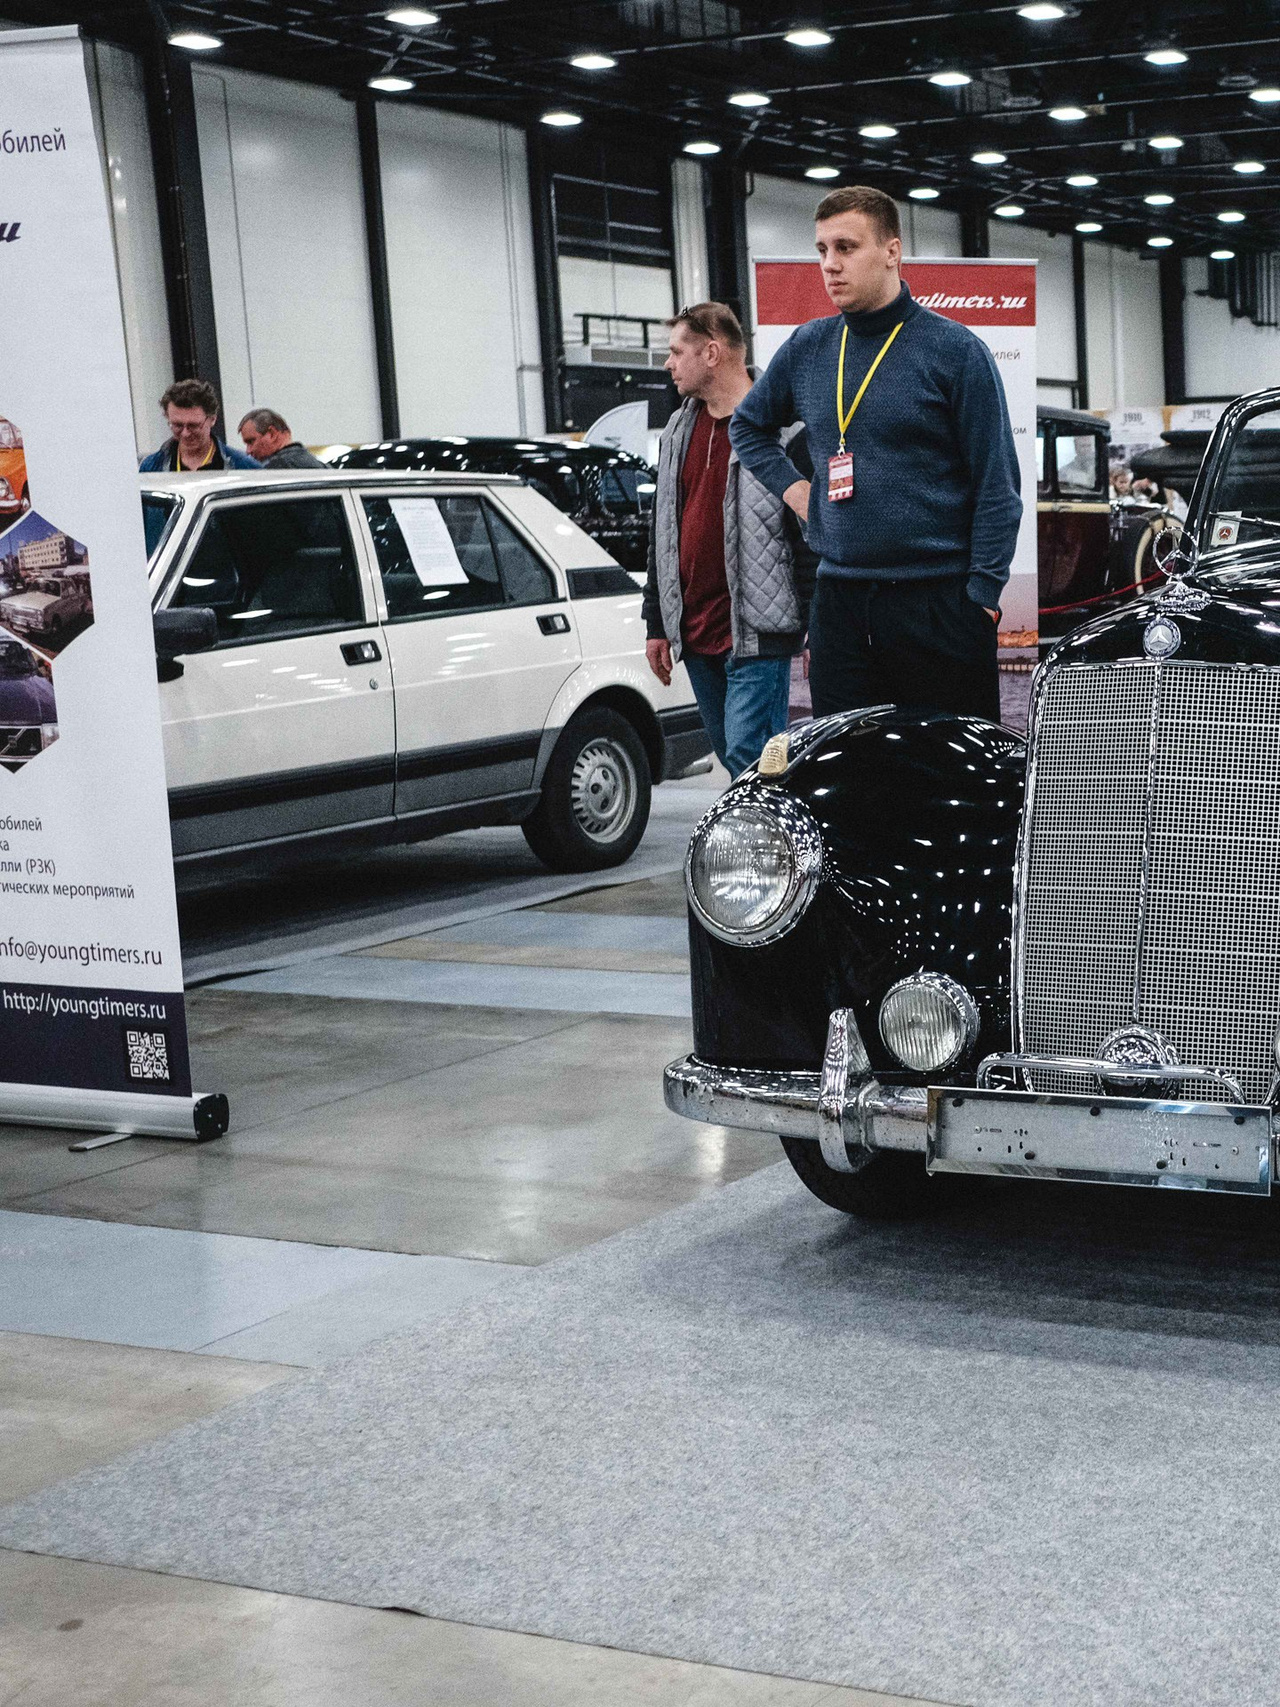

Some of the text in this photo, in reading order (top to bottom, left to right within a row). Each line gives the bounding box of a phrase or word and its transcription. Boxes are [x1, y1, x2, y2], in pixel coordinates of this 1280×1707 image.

[0, 127, 67, 154] билей
[53, 884, 135, 900] мероприятий
[3, 989, 167, 1020] http://youngtimers.ru
